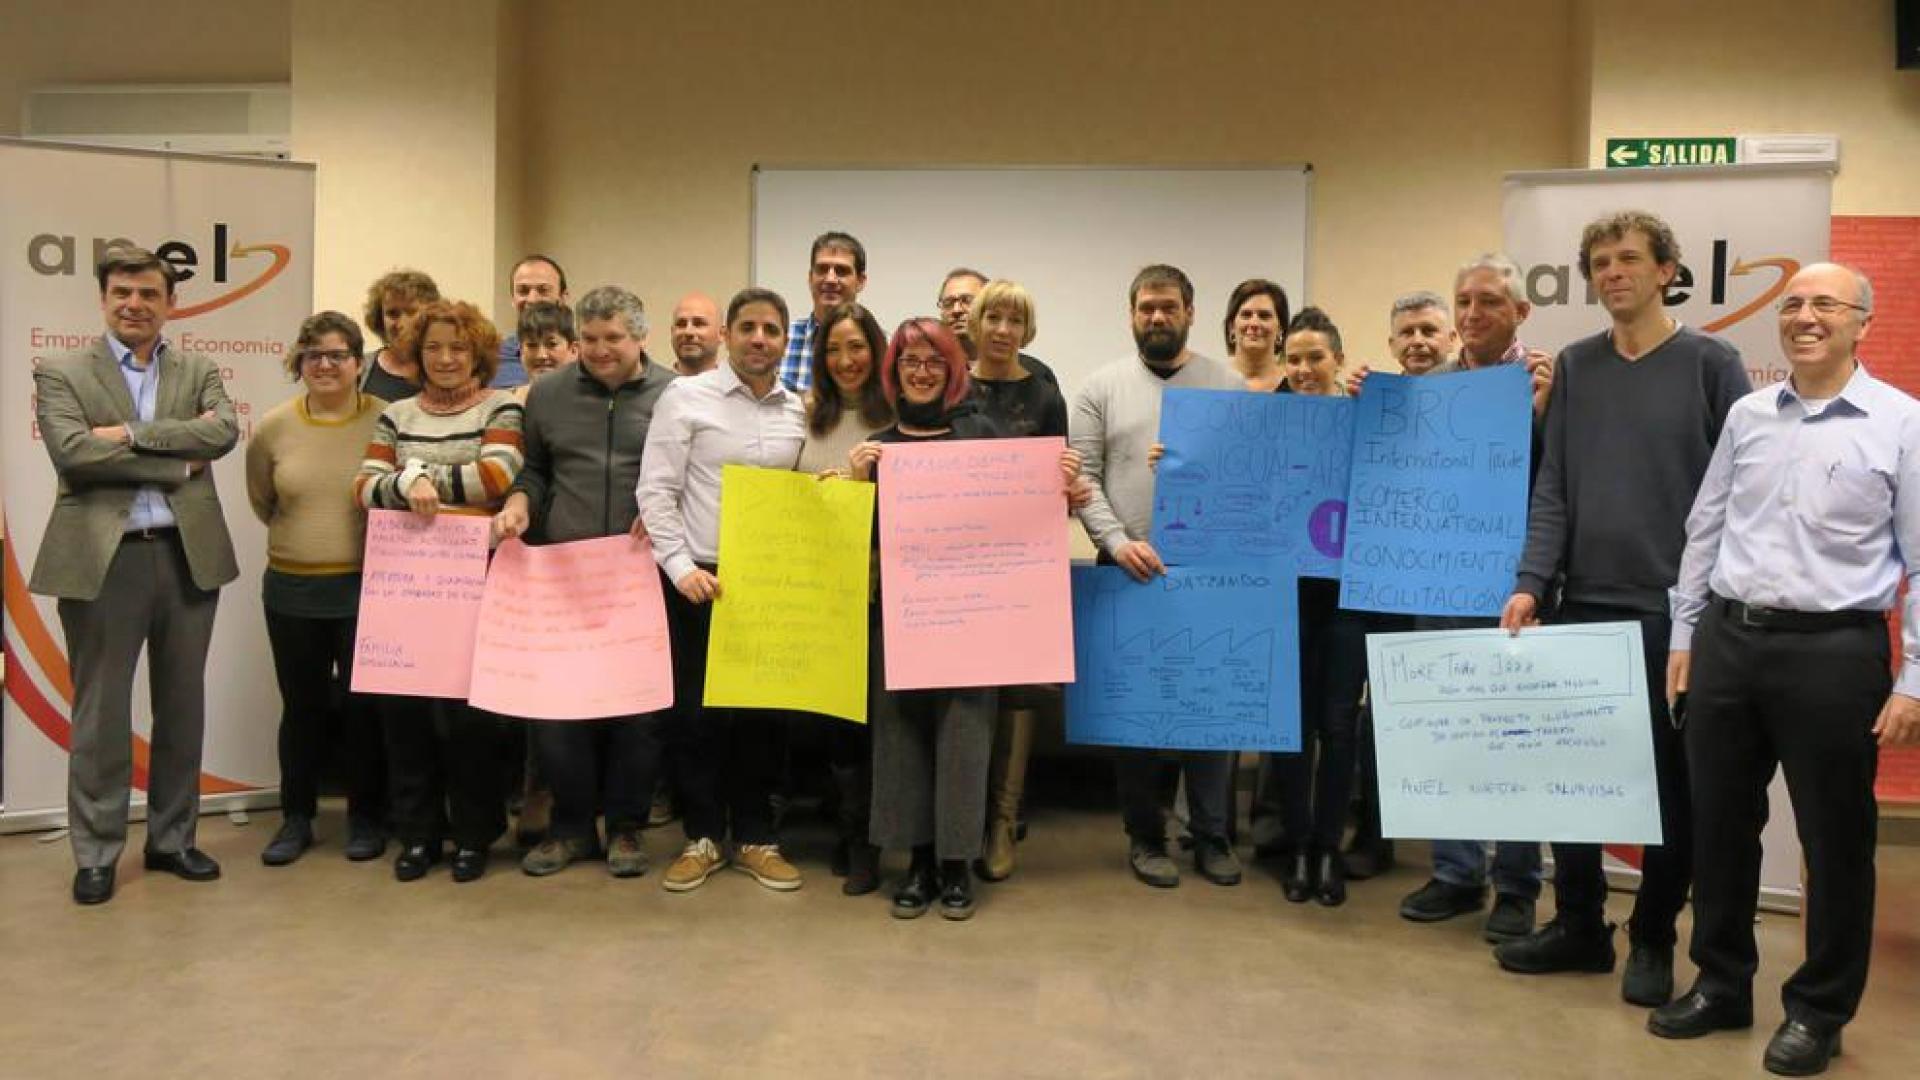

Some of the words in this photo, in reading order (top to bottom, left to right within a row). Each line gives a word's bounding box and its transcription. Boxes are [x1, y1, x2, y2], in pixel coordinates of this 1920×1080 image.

[1648, 144, 1728, 164] SALIDA
[1526, 240, 1728, 306] ael
[1371, 384, 1474, 441] BRC
[1364, 441, 1475, 471] International
[1355, 481, 1459, 513] COMERCIO
[1391, 650, 1437, 682] MORE
